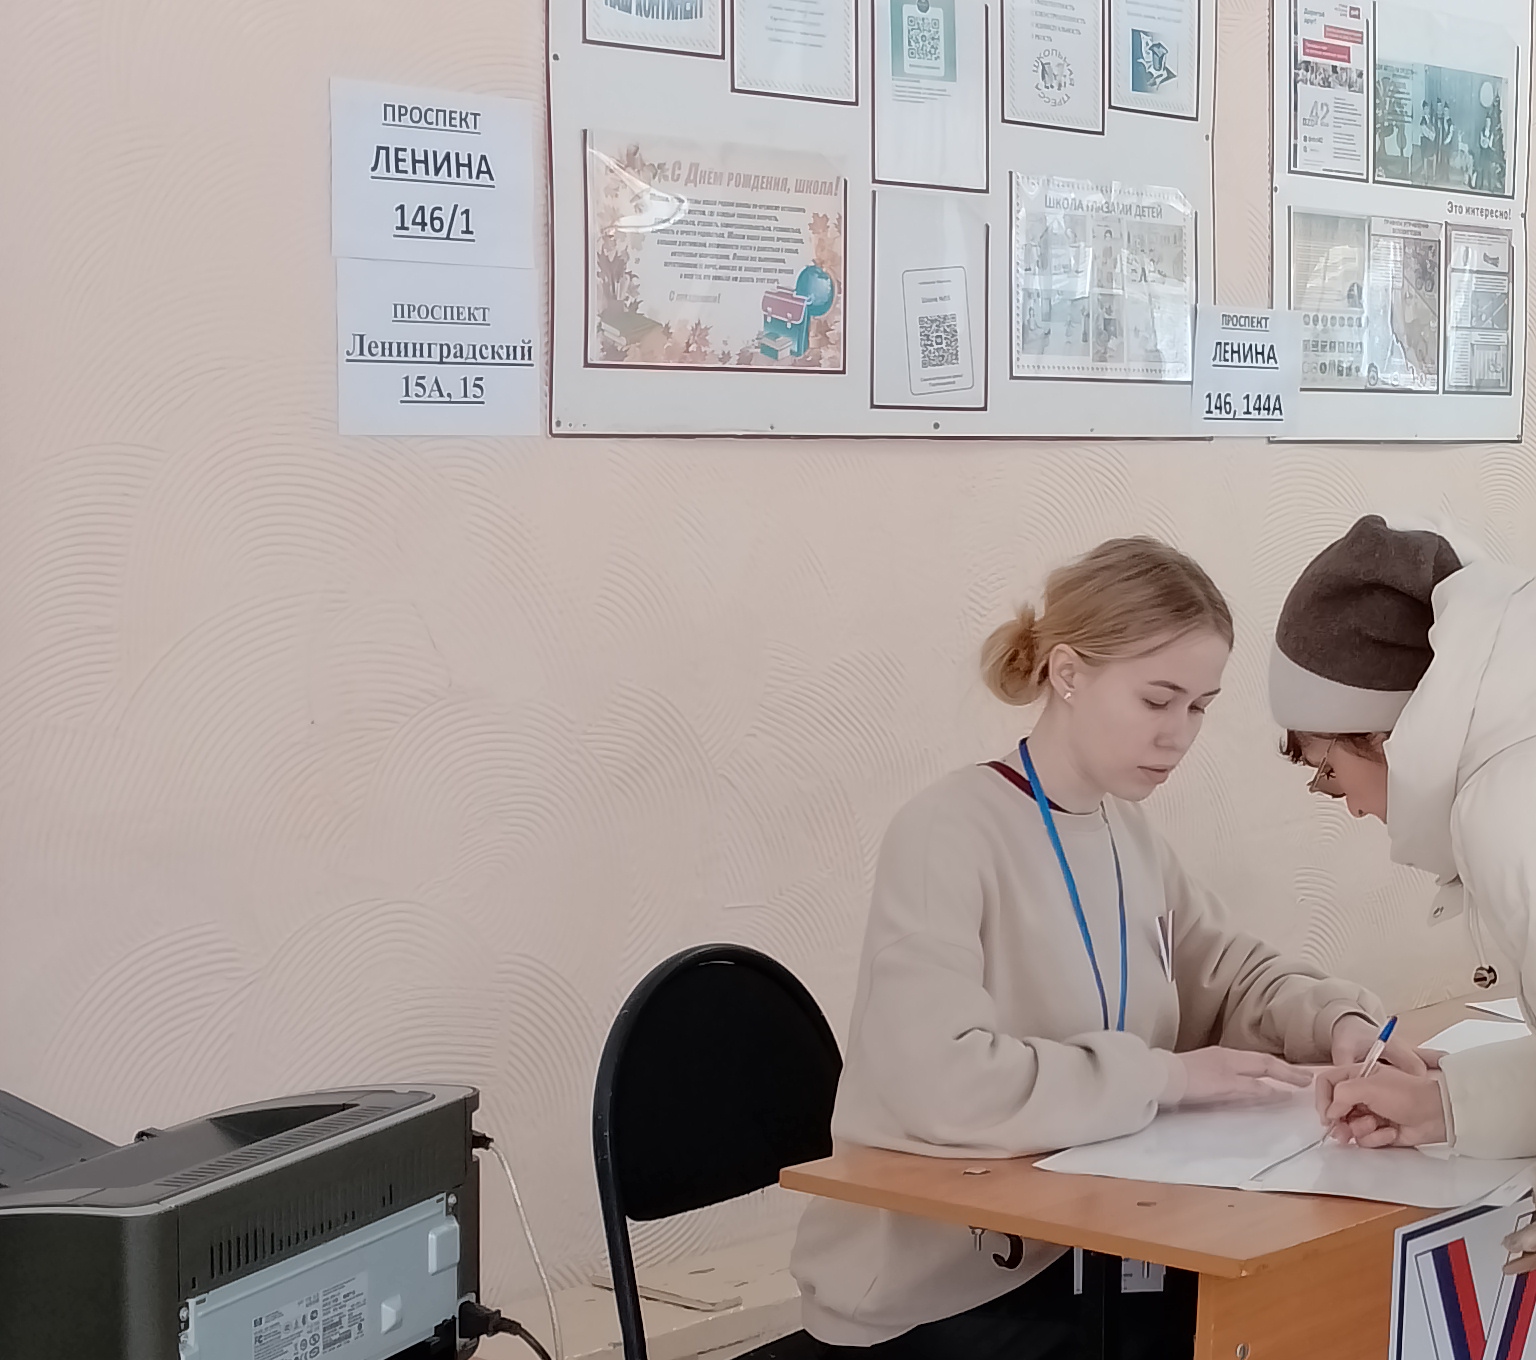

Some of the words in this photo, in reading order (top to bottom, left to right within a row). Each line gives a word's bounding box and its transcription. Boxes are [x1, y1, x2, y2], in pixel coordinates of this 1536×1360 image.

[382, 103, 481, 131] ПРОСПЕКТ
[370, 145, 495, 181] ЛЕНИНА
[1044, 194, 1084, 213] ШКОЛА
[1134, 203, 1163, 219] ДЕТЕЙ
[1447, 200, 1464, 216] Это
[1465, 204, 1513, 221] интересно!
[394, 203, 475, 238] 146/1
[392, 302, 491, 324] ПРОСПЕКТ
[1221, 313, 1270, 331] ПРОСПЕКТ
[346, 332, 534, 365] Ленинградский
[1212, 342, 1278, 366] ЛЕНИНА
[401, 374, 453, 402] 15А,
[460, 376, 485, 400] 15
[1204, 392, 1238, 419] 146,
[1242, 392, 1283, 417] 144А
